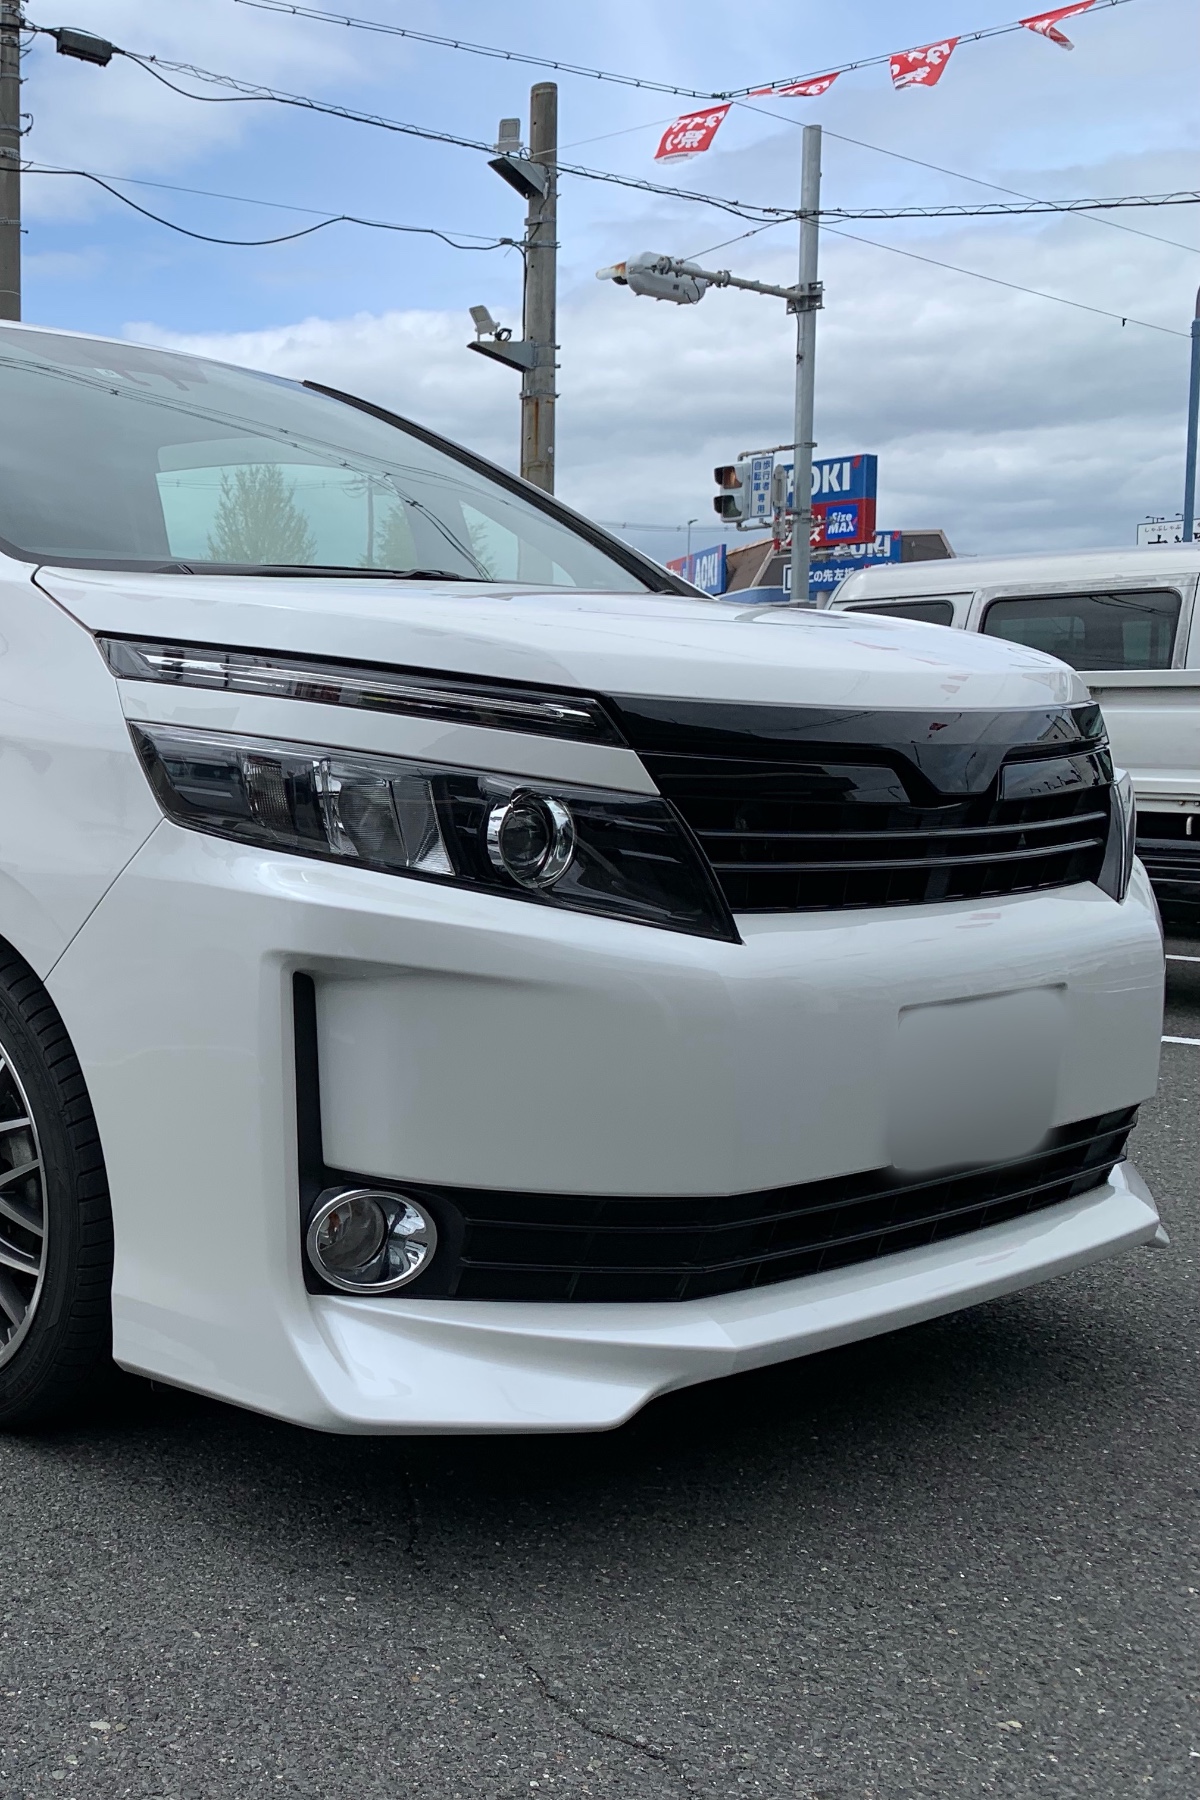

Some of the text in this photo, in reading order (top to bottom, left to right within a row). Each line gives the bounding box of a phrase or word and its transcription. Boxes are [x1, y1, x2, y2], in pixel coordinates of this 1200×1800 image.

[753, 460, 762, 491] 自転車
[763, 460, 771, 491] 歩行者
[757, 493, 766, 514] 専用
[828, 520, 855, 534] MAX
[831, 511, 853, 523] Size
[694, 552, 719, 590] AOKI
